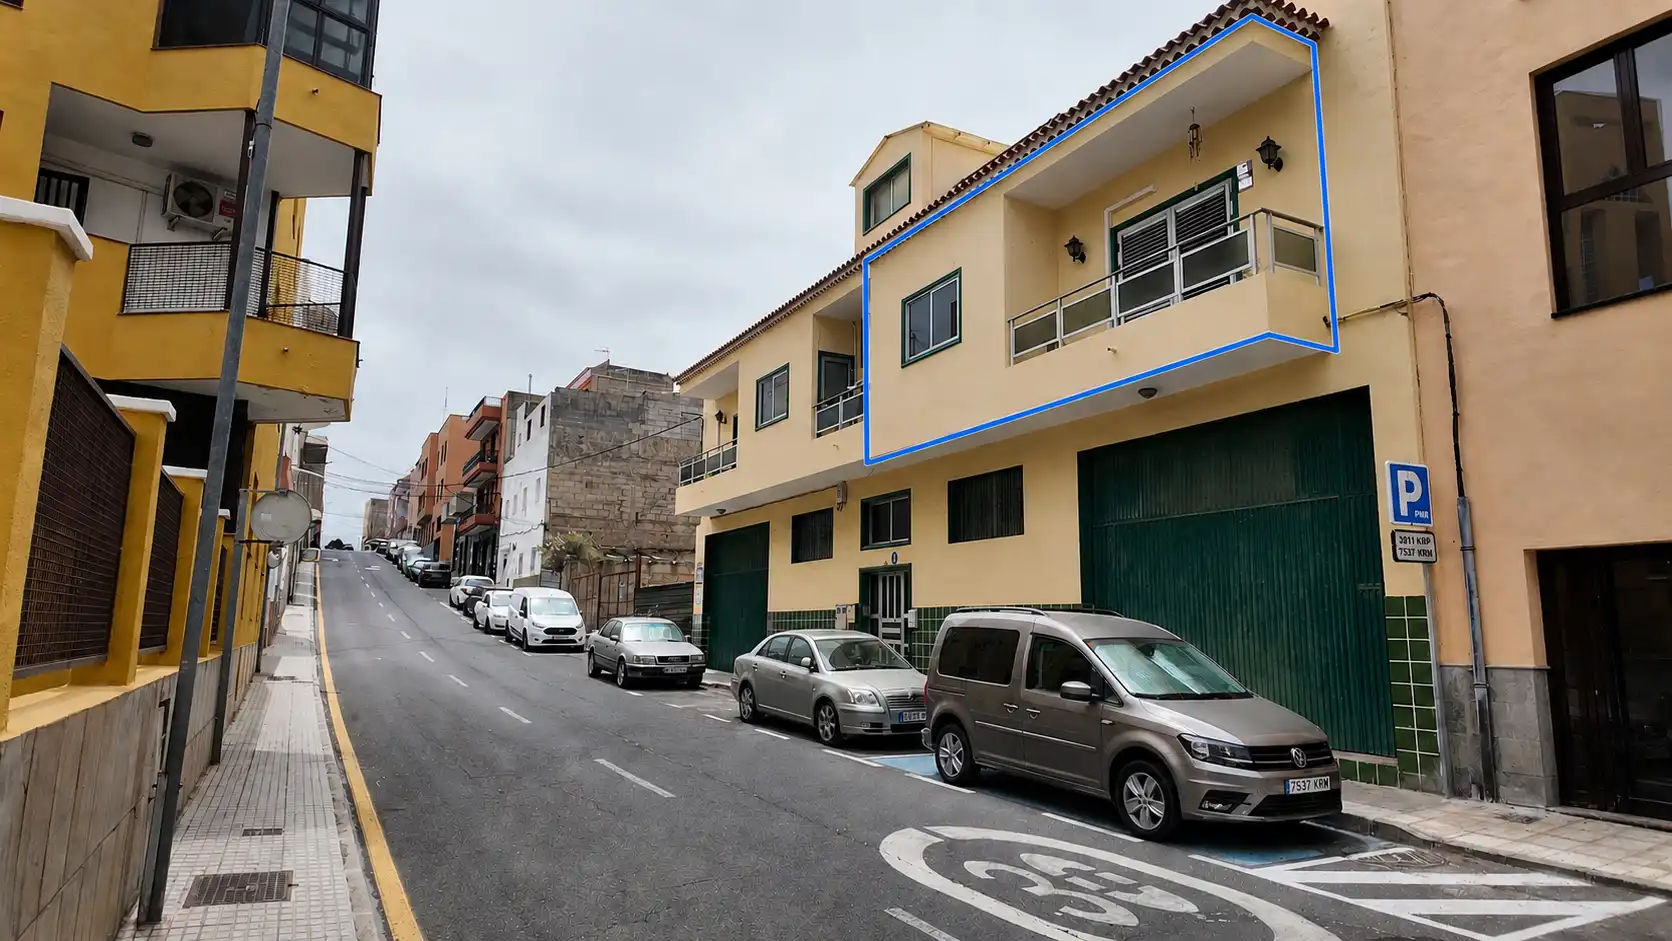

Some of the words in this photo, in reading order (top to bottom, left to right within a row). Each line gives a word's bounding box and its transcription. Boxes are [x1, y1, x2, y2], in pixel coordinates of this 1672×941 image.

[1397, 470, 1422, 516] P
[1414, 510, 1429, 519] PMR
[1398, 547, 1415, 557] 7537
[1290, 779, 1311, 793] 7537
[1313, 777, 1329, 790] KRM
